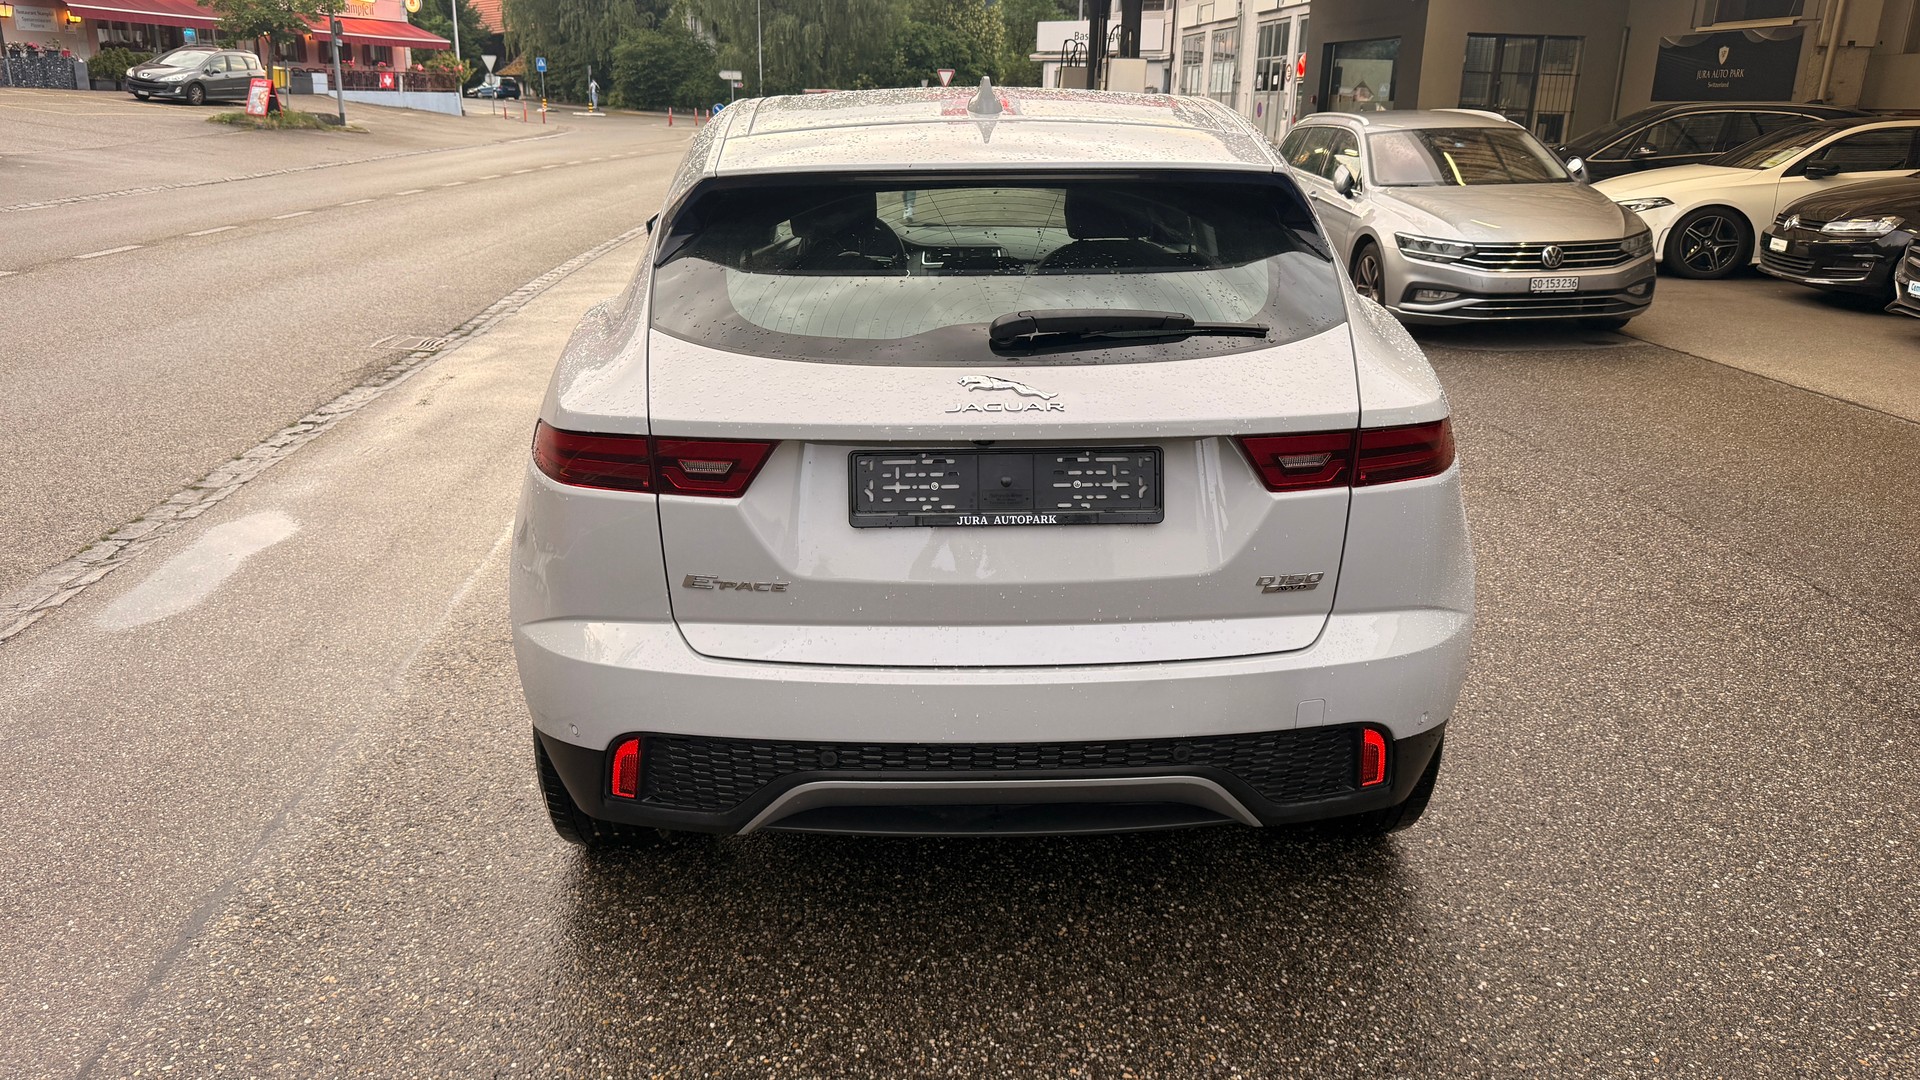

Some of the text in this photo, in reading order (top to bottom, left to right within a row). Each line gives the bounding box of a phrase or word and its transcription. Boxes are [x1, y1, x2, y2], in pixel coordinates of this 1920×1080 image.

[1696, 68, 1745, 80] JURA AUTO PARK
[945, 402, 1065, 413] JAGUAR
[956, 514, 1057, 525] JURA AUTOPARK
